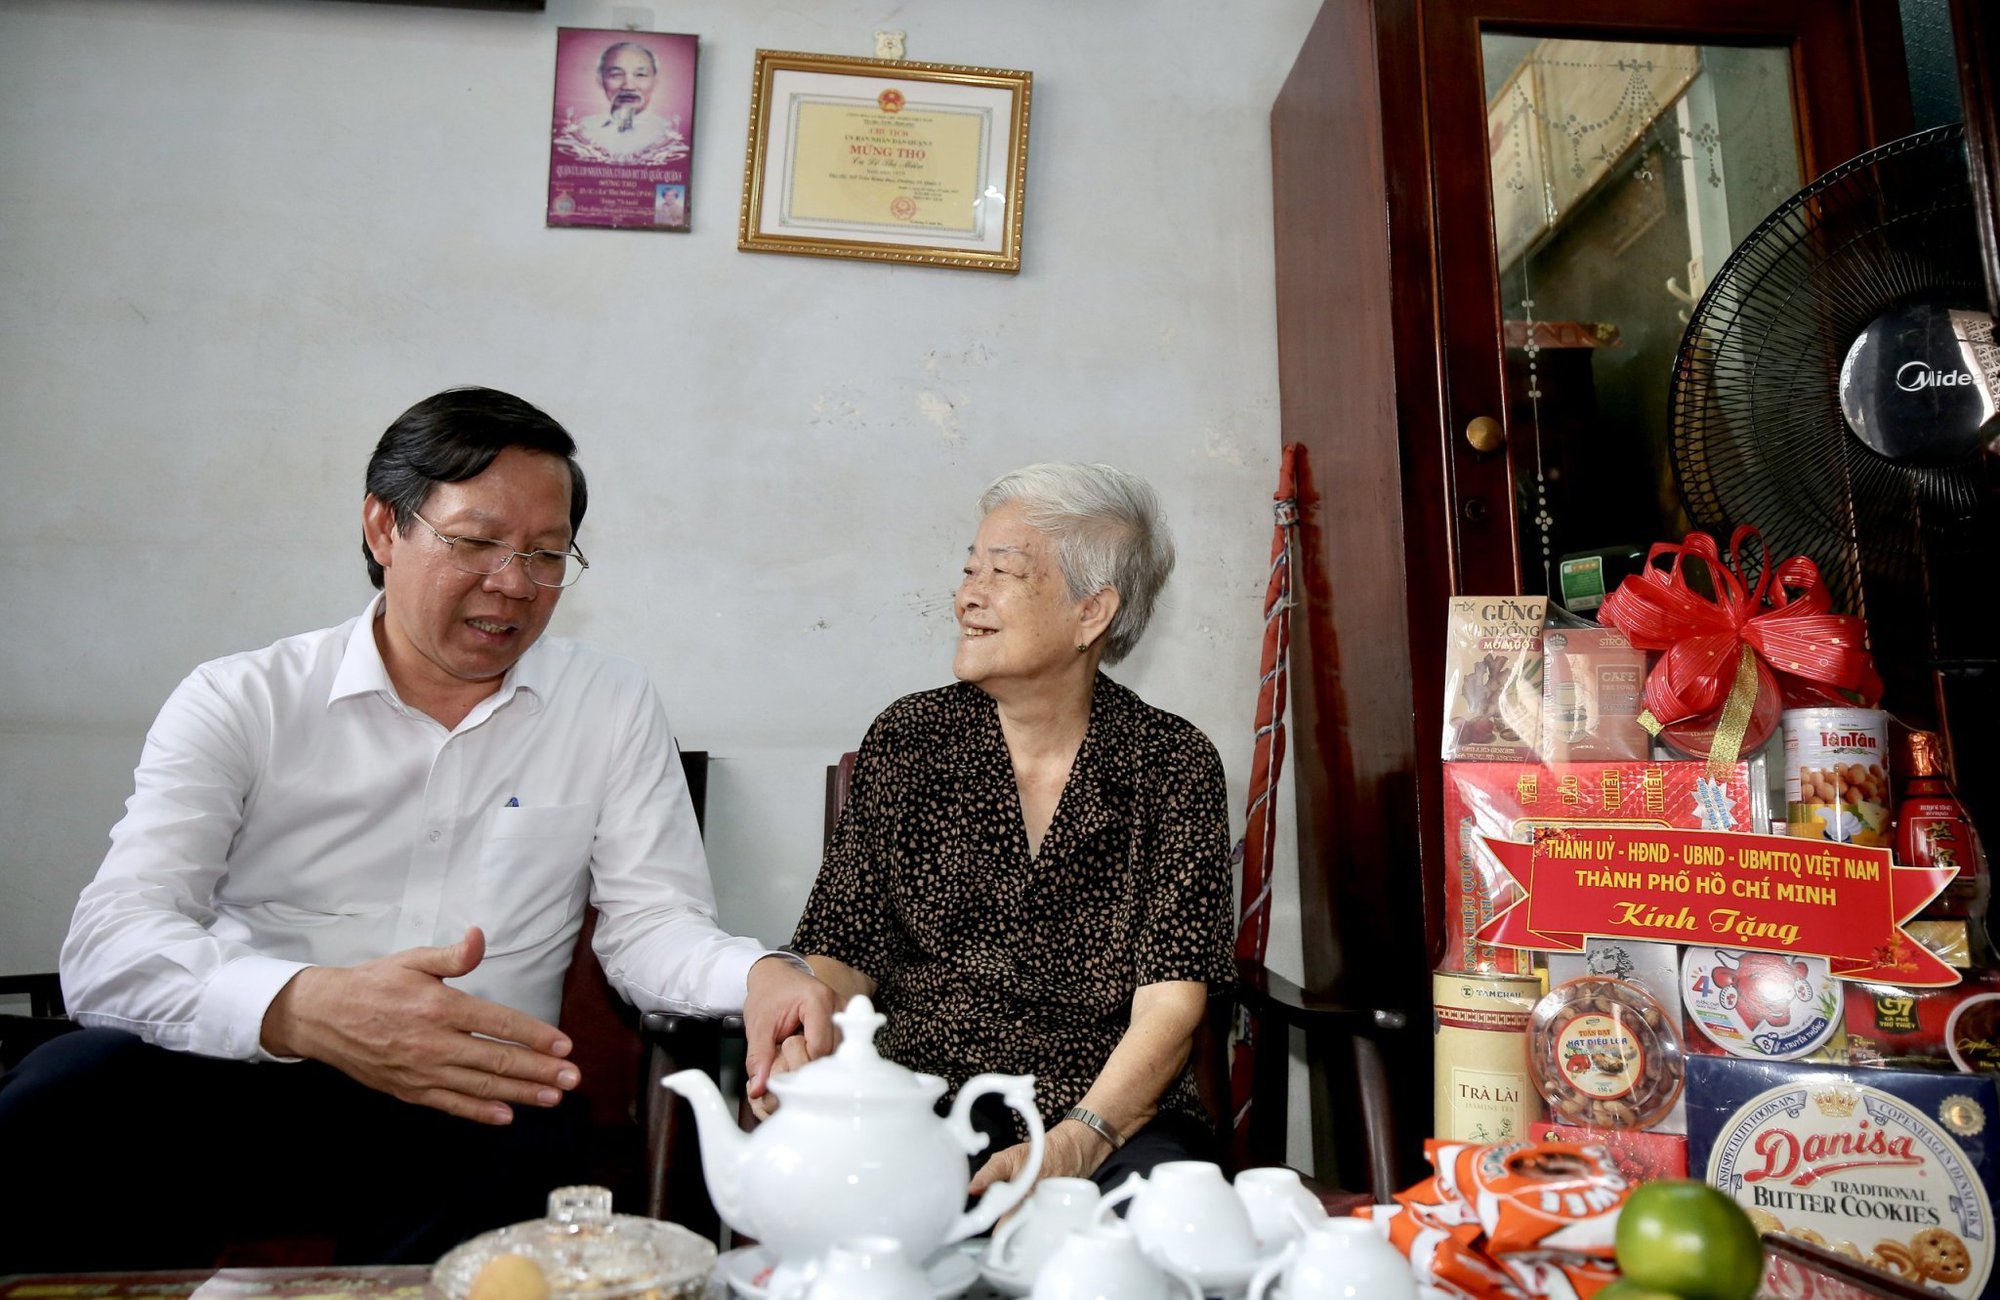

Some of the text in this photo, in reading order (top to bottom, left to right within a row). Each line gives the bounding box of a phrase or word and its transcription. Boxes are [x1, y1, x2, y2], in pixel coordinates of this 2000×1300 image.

[1482, 600, 1543, 620] GỪNG
[1600, 638, 1630, 647] STRON
[1600, 769, 1621, 811] THIÊN
[1642, 768, 1664, 812] NHIÊN
[1547, 834, 1592, 860] THÀNH
[1628, 842, 1670, 862] HĐND
[1683, 845, 1725, 866] UBND
[1738, 849, 1801, 878] UBMTTQ
[1804, 850, 1840, 881] VIỆT
[1845, 860, 1880, 881] NAM
[1575, 866, 1837, 906] THÀNH PHỐ HỒ CHÍ MINH
[1608, 901, 1802, 945] Kính Tặng
[1692, 975, 1713, 998] 4
[1877, 997, 1914, 1016] G7
[1459, 1084, 1519, 1102] TRÀ LÀI
[1743, 1119, 1925, 1185] Danisa
[1879, 1103, 1979, 1226] COPENHAGEN DENMARK
[1753, 1185, 1941, 1225] BUTTER COOKIES
[1832, 1181, 1929, 1202] TRADITIONAL
